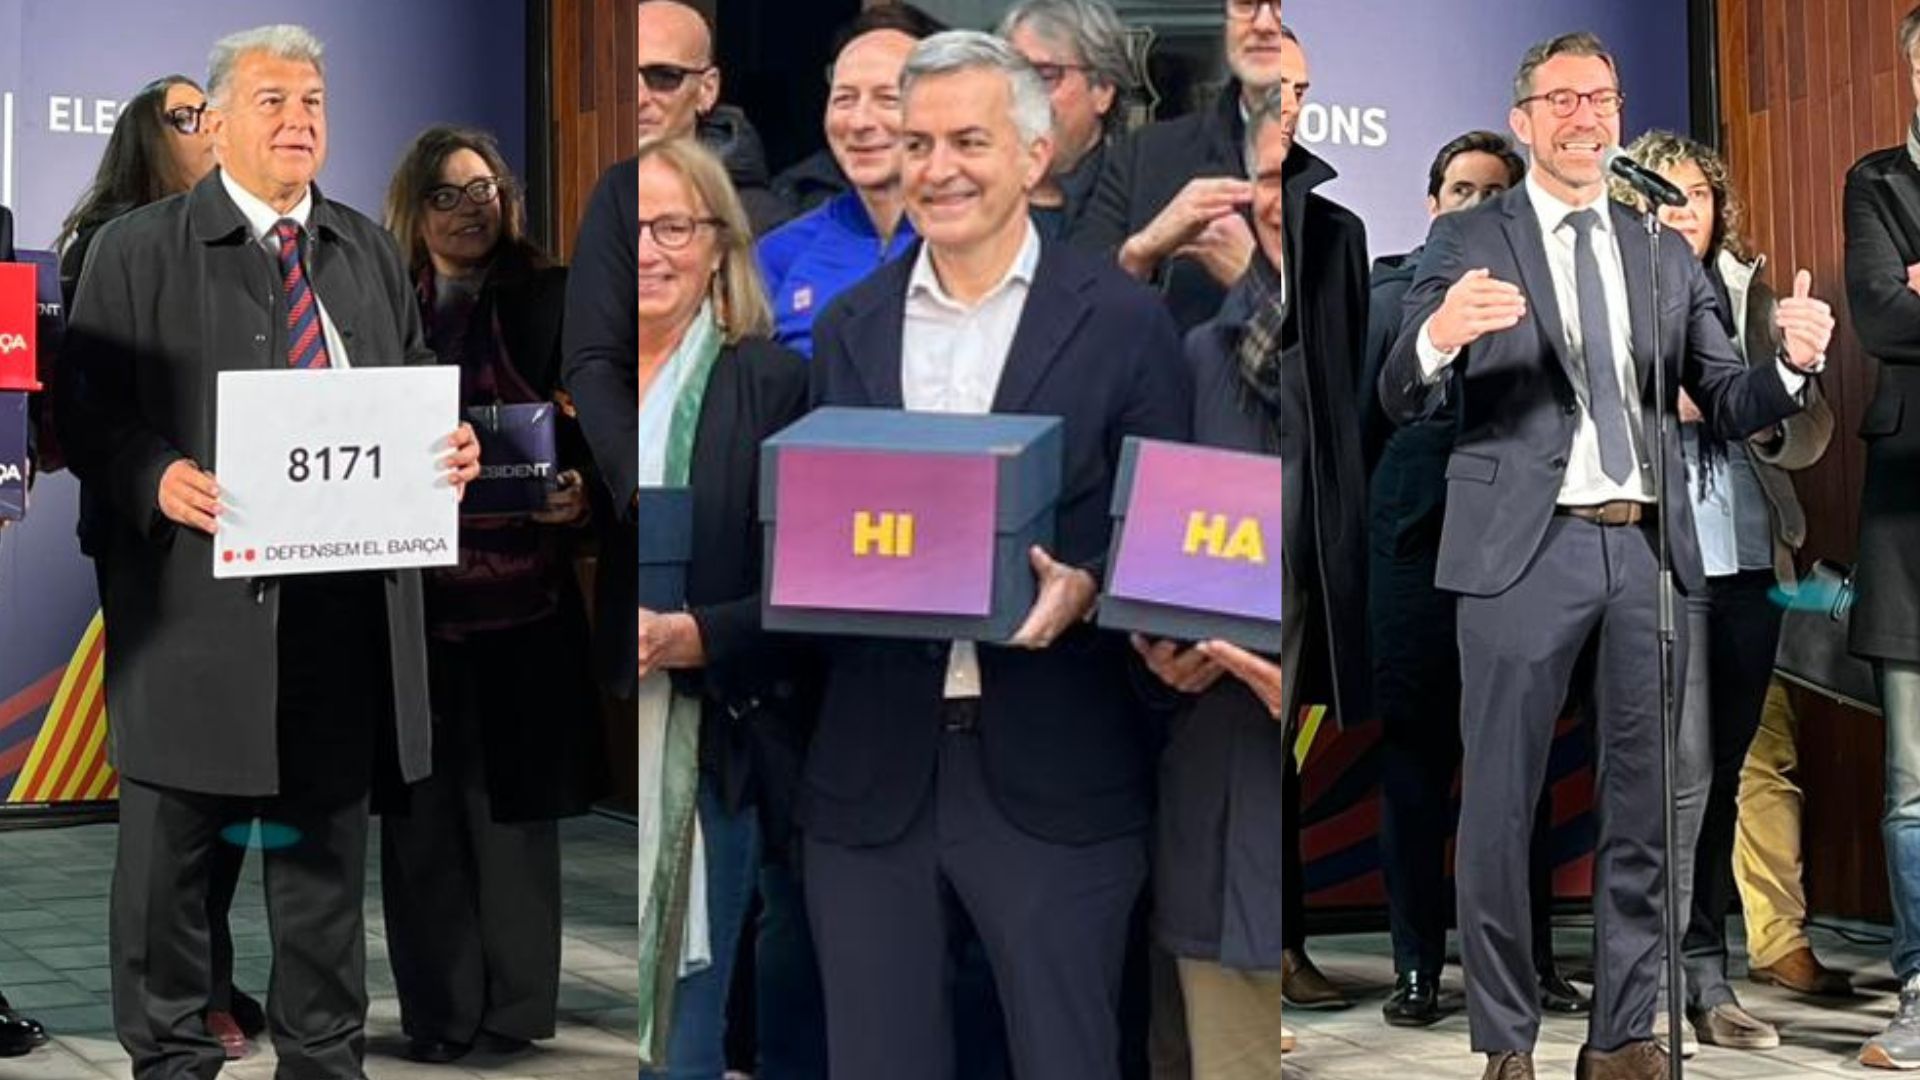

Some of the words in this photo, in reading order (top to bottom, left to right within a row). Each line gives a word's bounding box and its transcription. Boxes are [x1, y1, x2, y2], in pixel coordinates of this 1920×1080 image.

[50, 96, 130, 133] ELE
[1299, 103, 1388, 146] ONS
[37, 303, 61, 316] NT
[288, 445, 381, 481] 8171
[265, 541, 360, 561] DEFENSEM
[364, 541, 383, 555] EL
[388, 537, 448, 554] BARÇA
[852, 511, 914, 557] HI
[1183, 511, 1266, 564] HA
